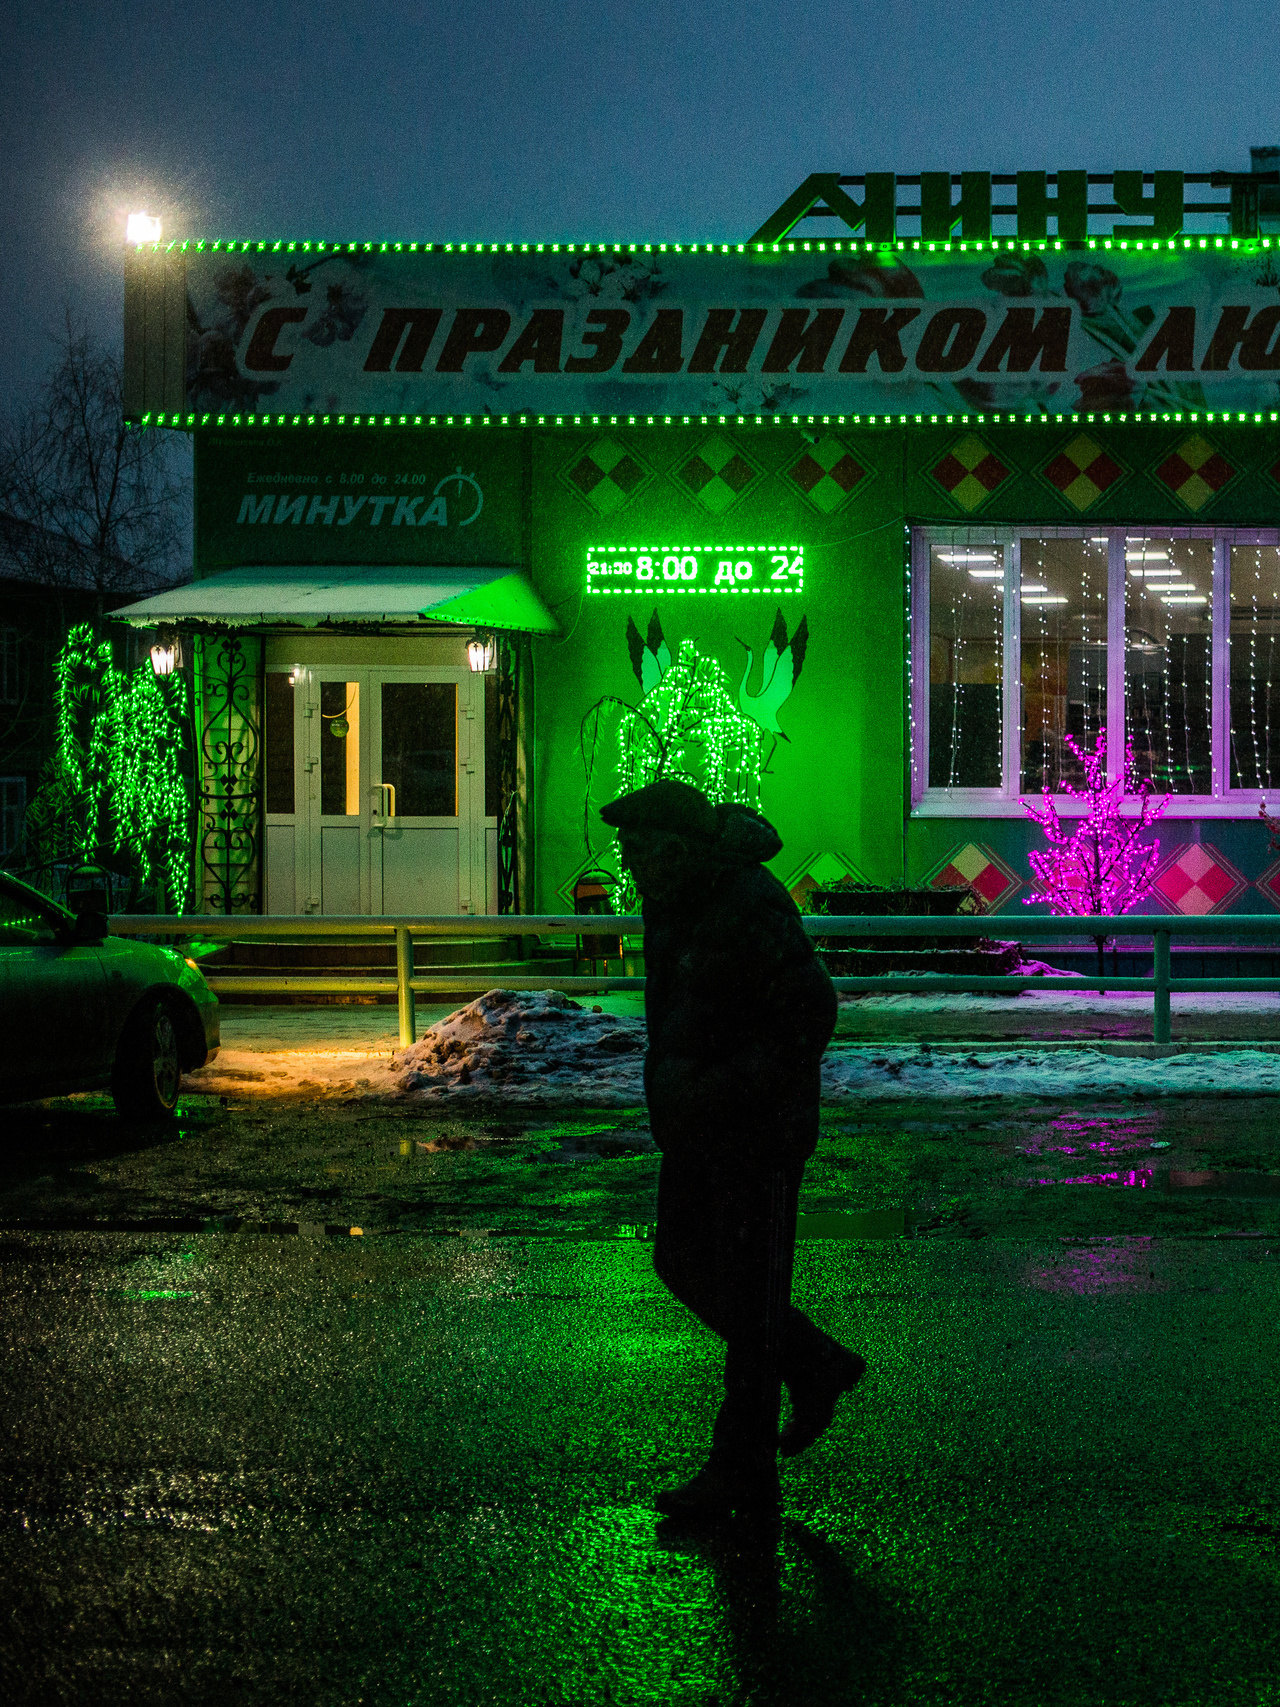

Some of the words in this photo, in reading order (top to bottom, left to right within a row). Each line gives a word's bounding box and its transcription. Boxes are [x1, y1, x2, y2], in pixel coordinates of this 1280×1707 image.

[243, 306, 308, 373] С
[362, 306, 1072, 373] ПРАЗДНИКОМ
[247, 472, 318, 485] Ежедневно
[325, 474, 333, 484] с
[371, 472, 387, 485] до
[394, 473, 427, 485] 24.00
[236, 494, 448, 527] МИНУТКА
[636, 556, 698, 581] 8:00
[714, 561, 753, 586] до
